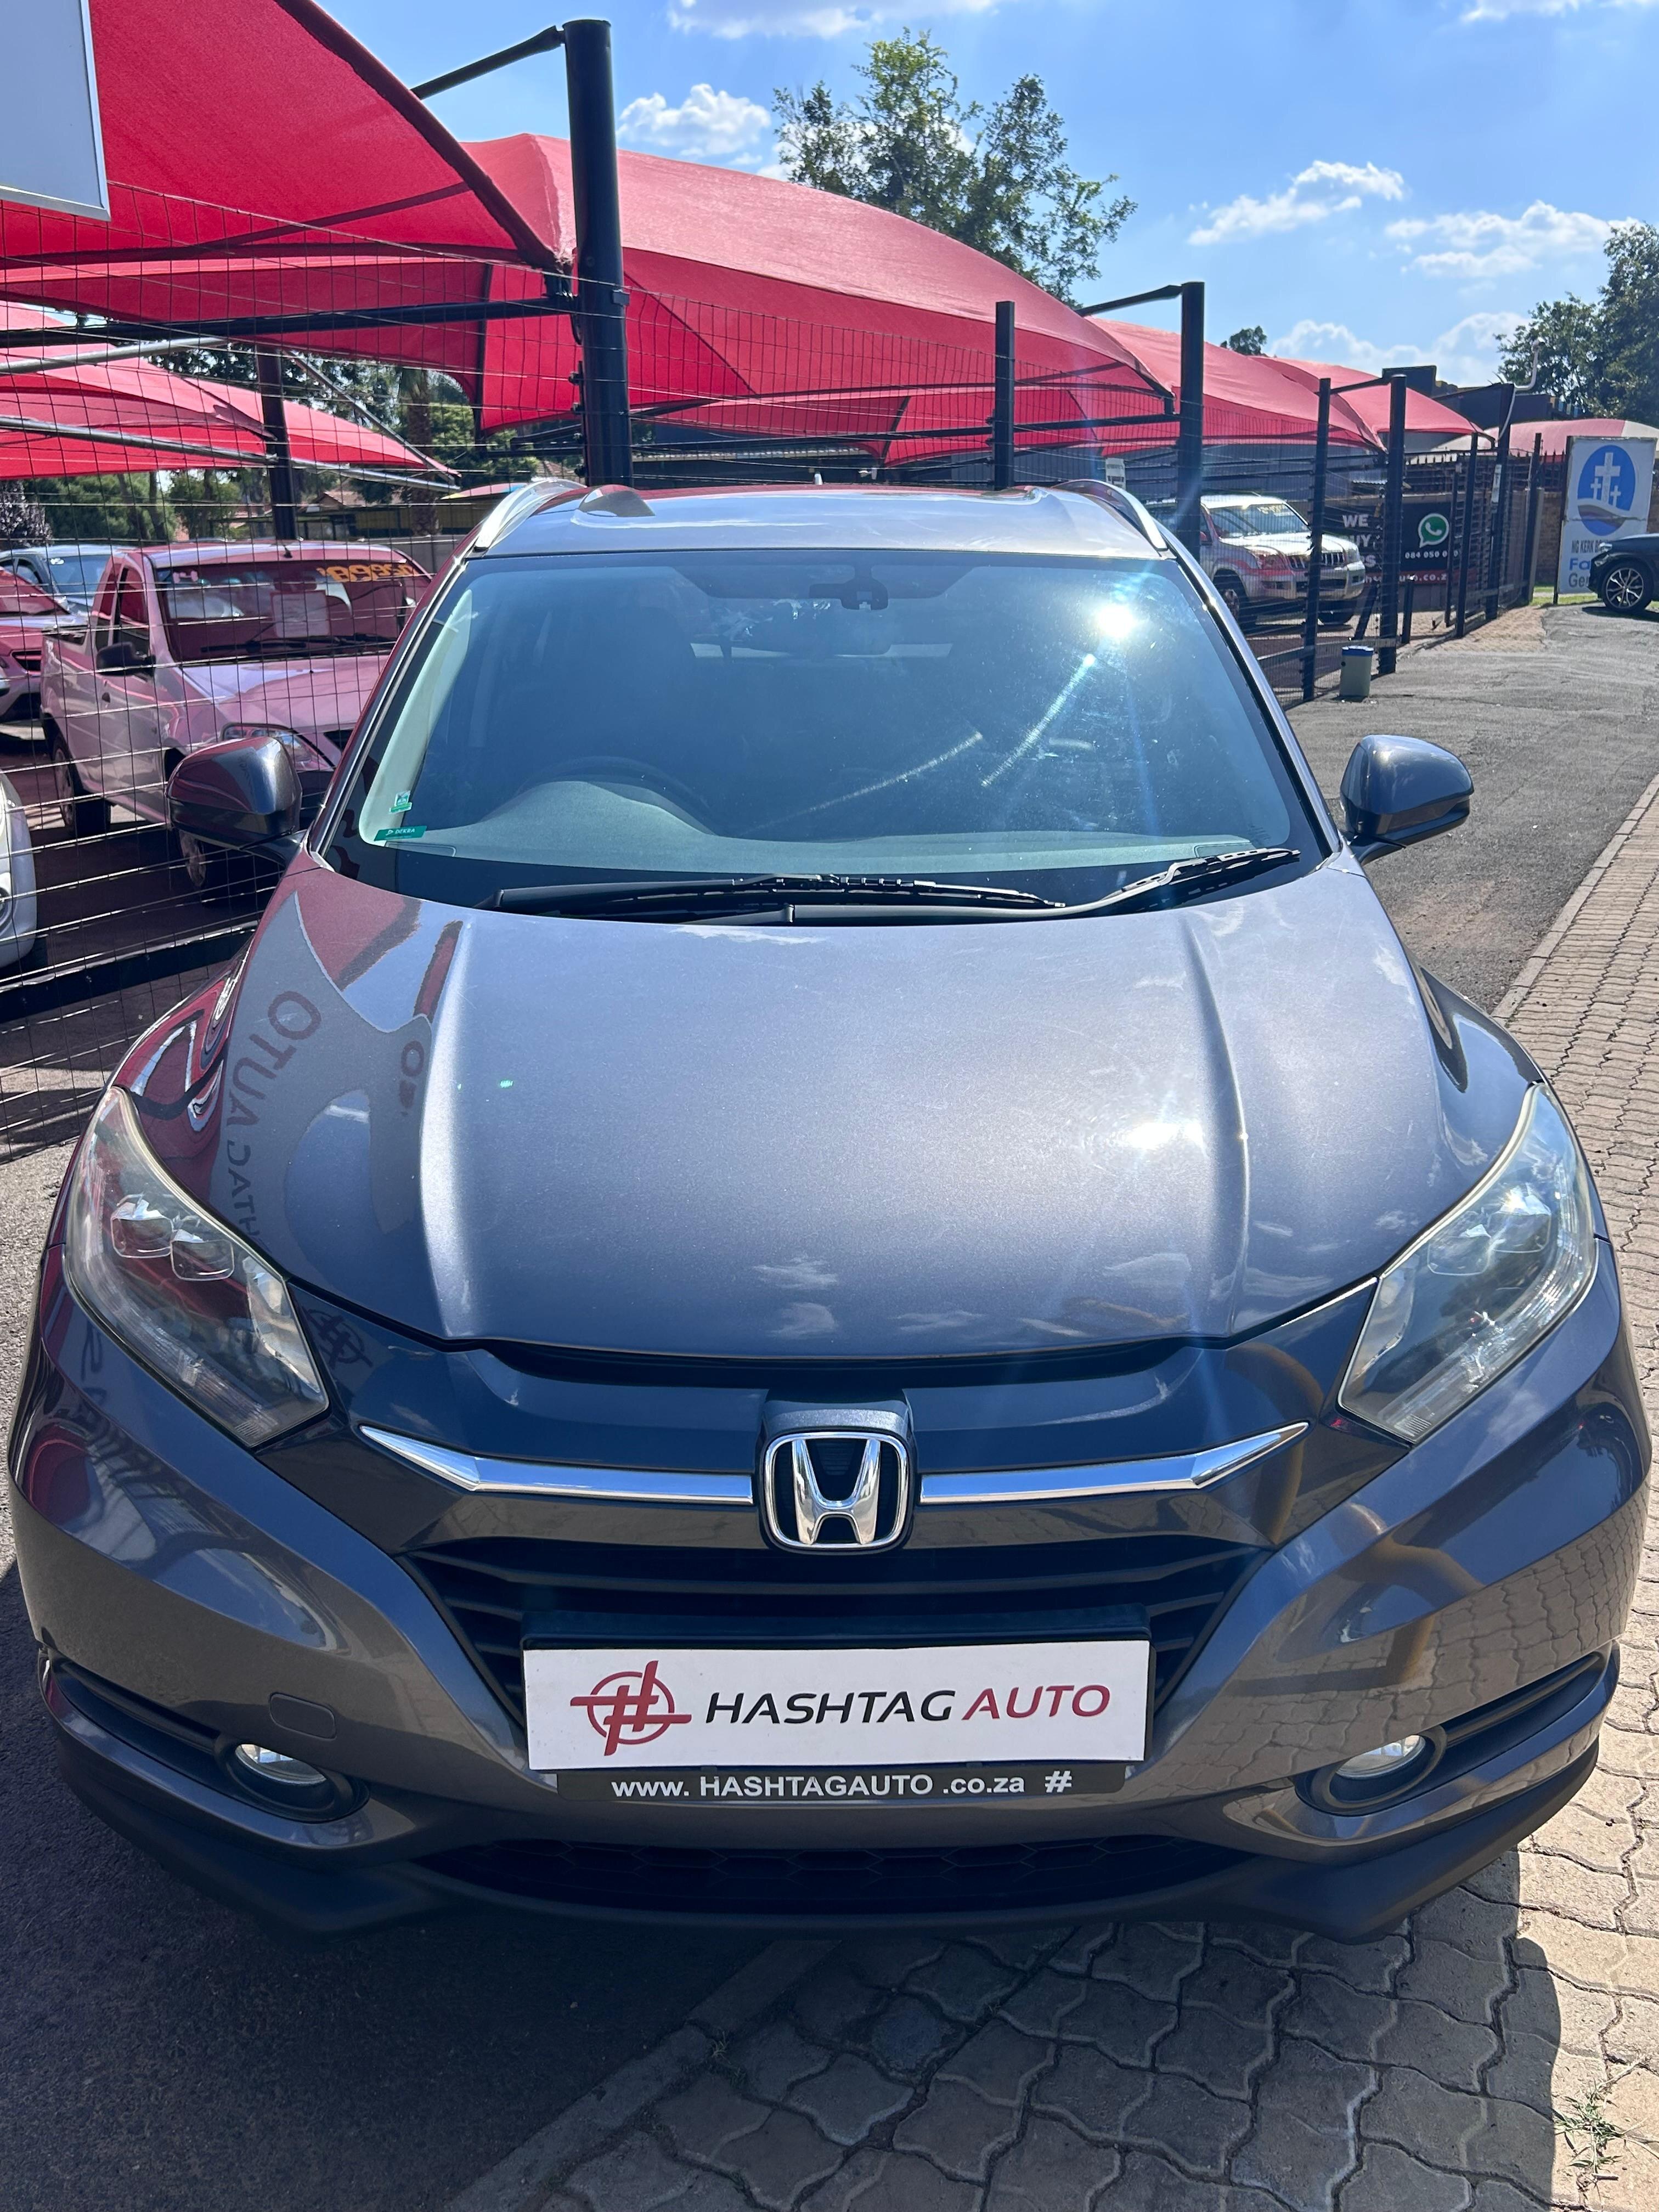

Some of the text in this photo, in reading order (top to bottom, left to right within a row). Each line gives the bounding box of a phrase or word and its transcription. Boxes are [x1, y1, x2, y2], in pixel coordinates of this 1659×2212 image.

[1342, 514, 1369, 527] WE
[1341, 534, 1372, 547] UY
[705, 1690, 956, 1724] HASHTAG
[961, 1684, 1111, 1721] AUTO
[611, 1781, 690, 1797] www.
[699, 1774, 933, 1797] HASHTAGAUTO
